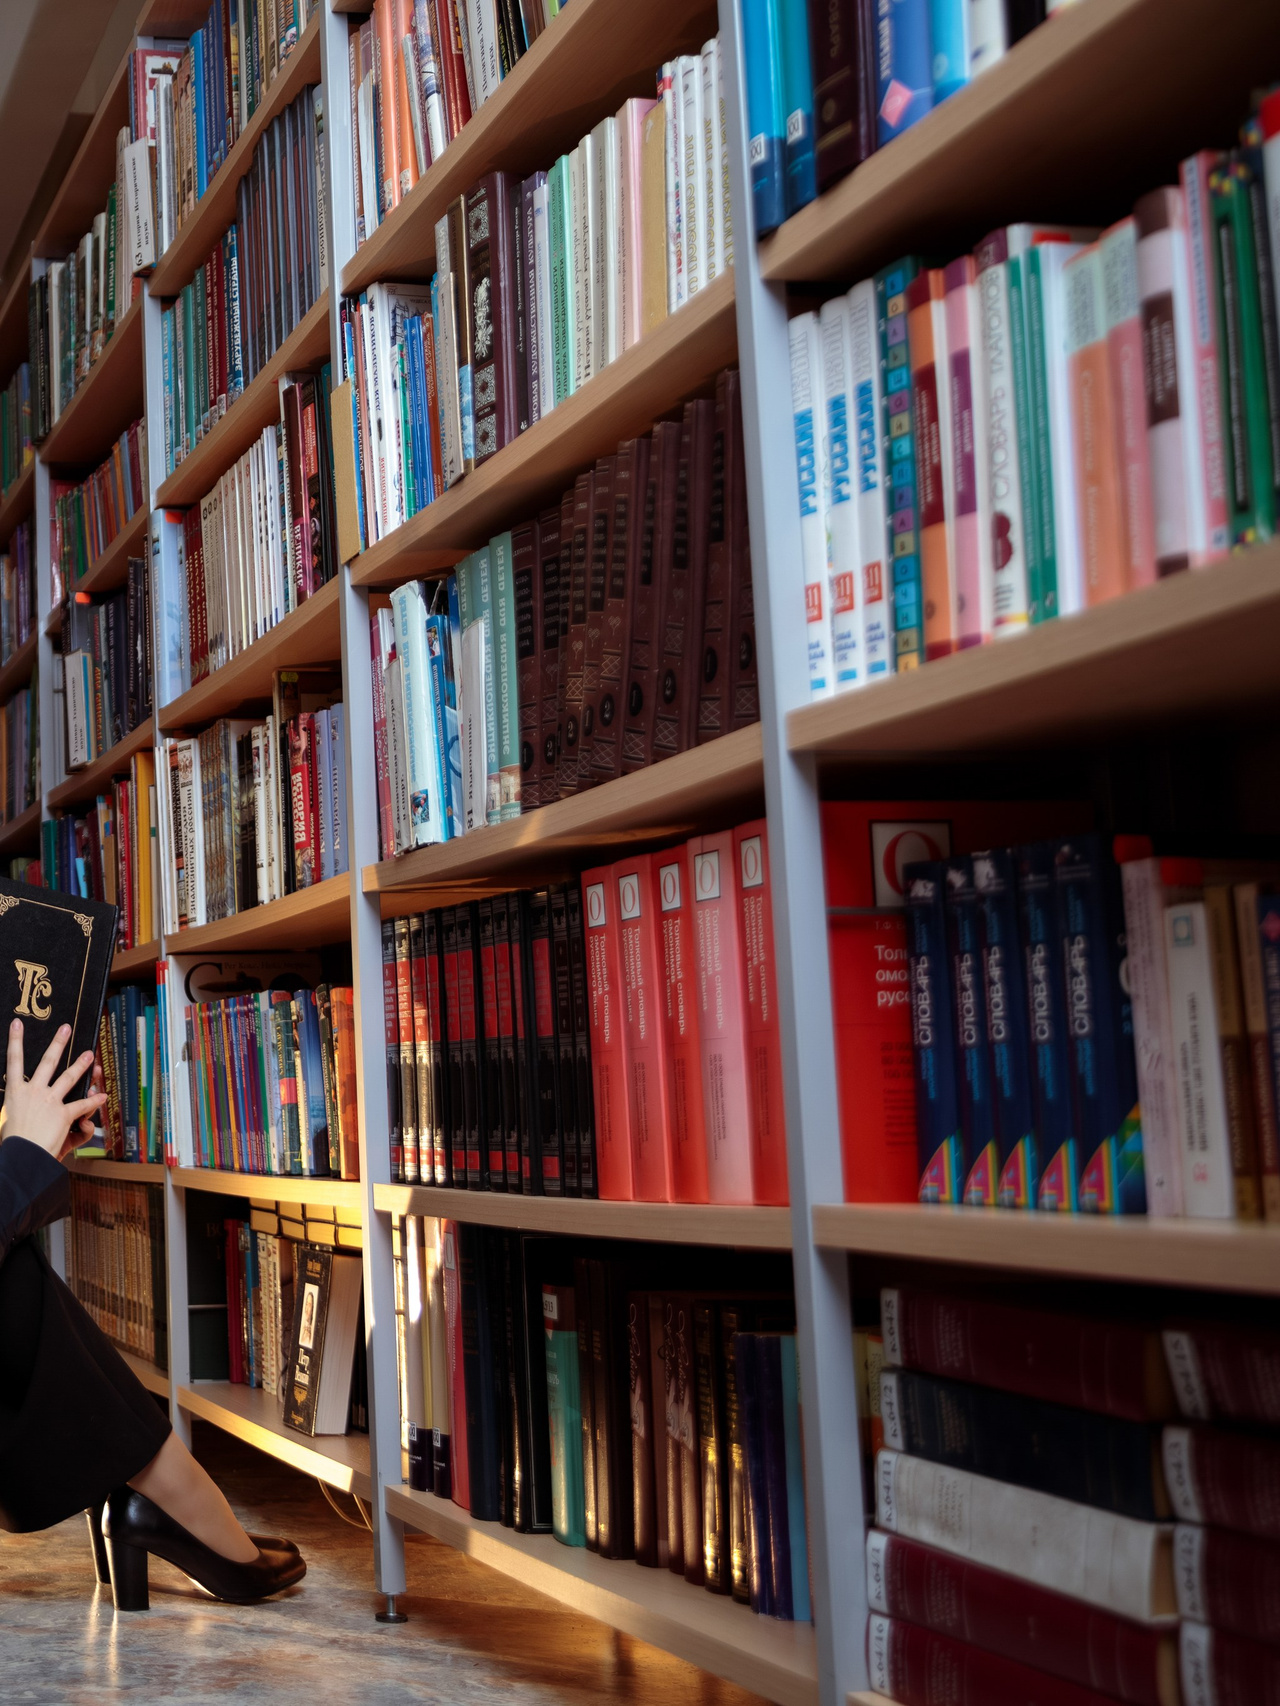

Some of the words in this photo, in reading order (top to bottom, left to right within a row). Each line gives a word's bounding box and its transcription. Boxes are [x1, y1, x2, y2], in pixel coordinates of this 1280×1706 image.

[131, 157, 140, 211] Исторические
[134, 251, 143, 267] 63
[525, 207, 535, 264] КУЛЬТУРА
[230, 257, 239, 298] СТРАНЫ
[558, 258, 567, 348] ПОВСЕДНЕВНОСТИ
[232, 299, 241, 371] ЗАРУБЕЖНЫЕ
[528, 269, 539, 374] ХУДОЖЕСТВЕННАЯ
[551, 266, 561, 354] ПОВСЕДНЕВНОСТИ
[368, 316, 379, 386] МАЛЬЧИКОВ
[373, 389, 381, 410] ДЛЯ
[531, 381, 539, 424] ИРОВАЯ
[793, 408, 818, 517] РУССКИЙ
[827, 393, 851, 505] РУССКИЙ
[855, 379, 877, 493] РУССКИЙ
[294, 524, 304, 588] ВЕЛИКИЕ
[479, 558, 489, 603] ДЕТЕЙ
[495, 545, 505, 591] ДЕТЕЙ
[481, 609, 491, 638] ДЛЯ
[498, 598, 507, 627] ДЛЯ
[390, 698, 398, 750] культура
[484, 644, 496, 763] ЭНЦИКЛОПЕДИЯ
[500, 633, 510, 755] ЭНЦИКЛОПЕДИЯ
[296, 772, 306, 841] ИСТОРИЯ
[393, 754, 401, 823] Физическая
[466, 808, 473, 829] 81
[396, 830, 402, 850] 75
[187, 837, 196, 915] ЗНАМЕНИТЫХ
[622, 929, 630, 981] русского
[627, 927, 636, 989] омонимов
[633, 925, 644, 985] Толковый
[662, 920, 671, 974] русского
[667, 919, 676, 982] омонимов
[673, 916, 684, 979] Толковый
[697, 909, 707, 966] русского
[704, 908, 714, 975] омонимов
[711, 908, 724, 970] Толковый
[742, 897, 752, 956] русского
[747, 961, 755, 1004] языка
[748, 896, 758, 965] омонимов
[755, 895, 766, 960] Толковый
[589, 936, 597, 988] русского
[594, 935, 602, 994] омонимов
[600, 934, 610, 991] Толковый
[701, 971, 709, 1010] языка
[760, 964, 769, 1021] словарь
[988, 945, 1006, 1040] СЛОВАРЬ
[1031, 943, 1050, 1040] СЛОВАРЬ
[1070, 935, 1091, 1034] СЛОВАРЬ
[603, 995, 611, 1043] словарь
[638, 988, 646, 1040] словарь
[677, 982, 686, 1035] словарь
[715, 975, 725, 1030] словарь
[916, 955, 933, 1045] СЛОВАРЬ
[960, 953, 977, 1045] СЛОВАРЬ
[100, 1016, 112, 1092] МЕДИЦИНСКАЯ
